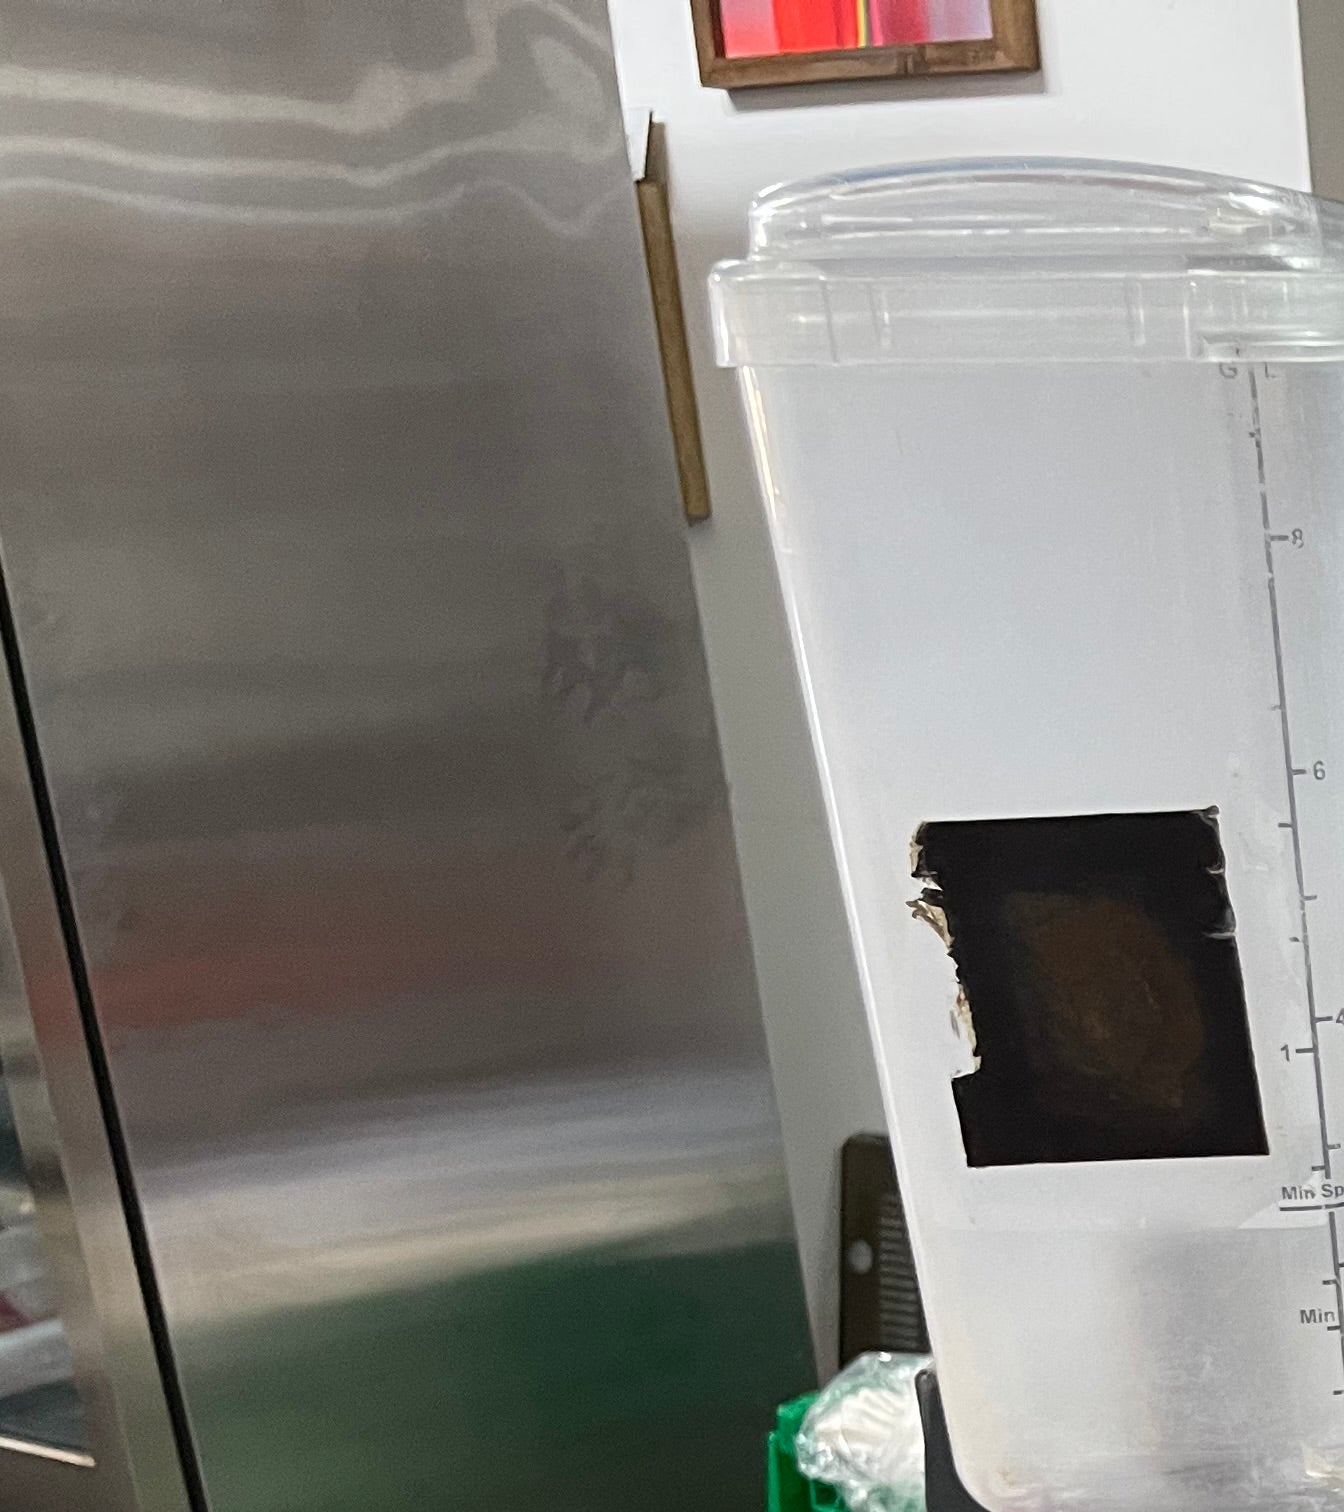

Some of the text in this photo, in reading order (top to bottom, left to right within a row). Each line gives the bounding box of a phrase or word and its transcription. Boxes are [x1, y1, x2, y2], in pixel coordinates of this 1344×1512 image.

[1313, 761, 1326, 781] 6
[1280, 1044, 1290, 1061] 1
[1282, 1184, 1316, 1201] Min
[1300, 1307, 1335, 1324] Min
